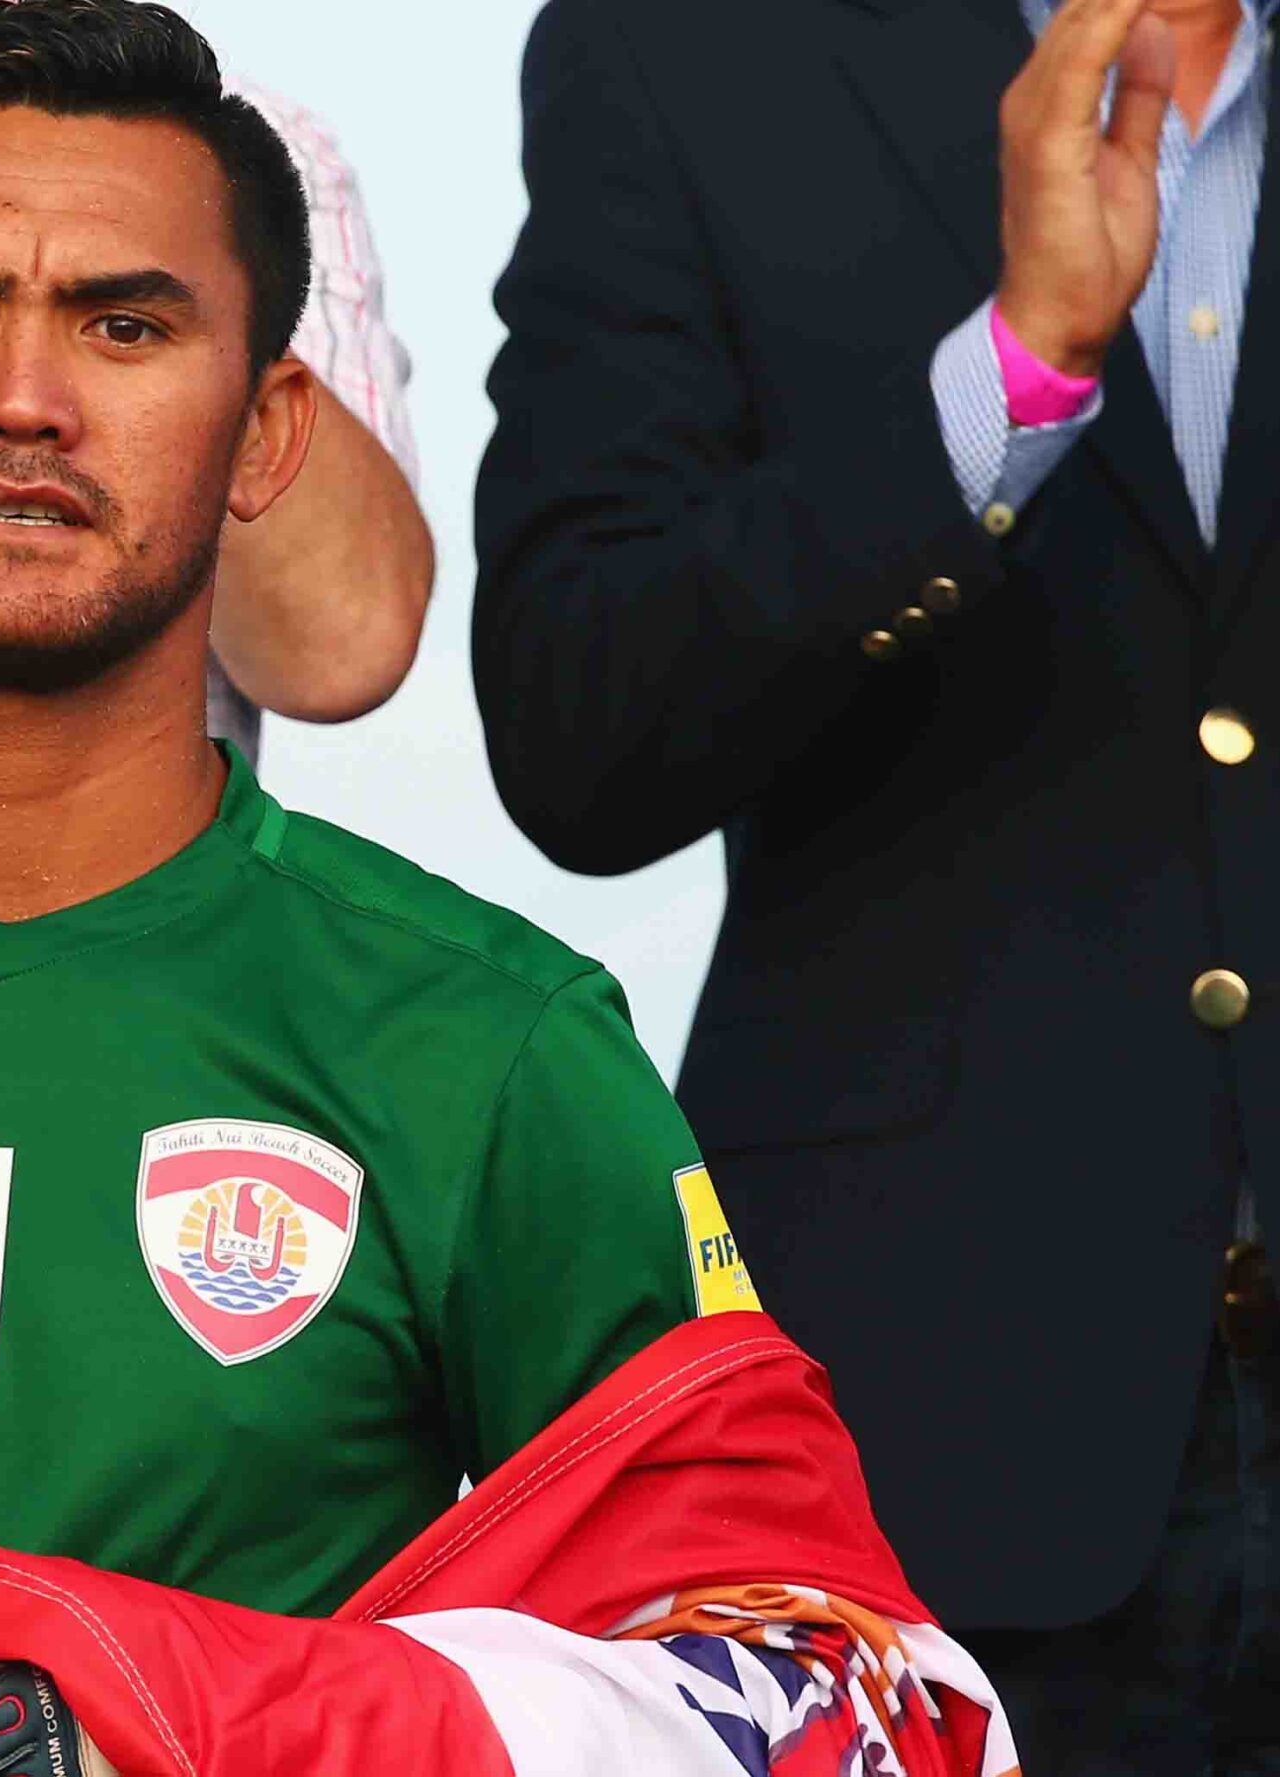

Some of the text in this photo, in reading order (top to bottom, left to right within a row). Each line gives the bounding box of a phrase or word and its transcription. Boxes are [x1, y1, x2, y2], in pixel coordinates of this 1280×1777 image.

[157, 1128, 349, 1183] Tahiti Nui Beach Soccer
[699, 1232, 742, 1274] FIF
